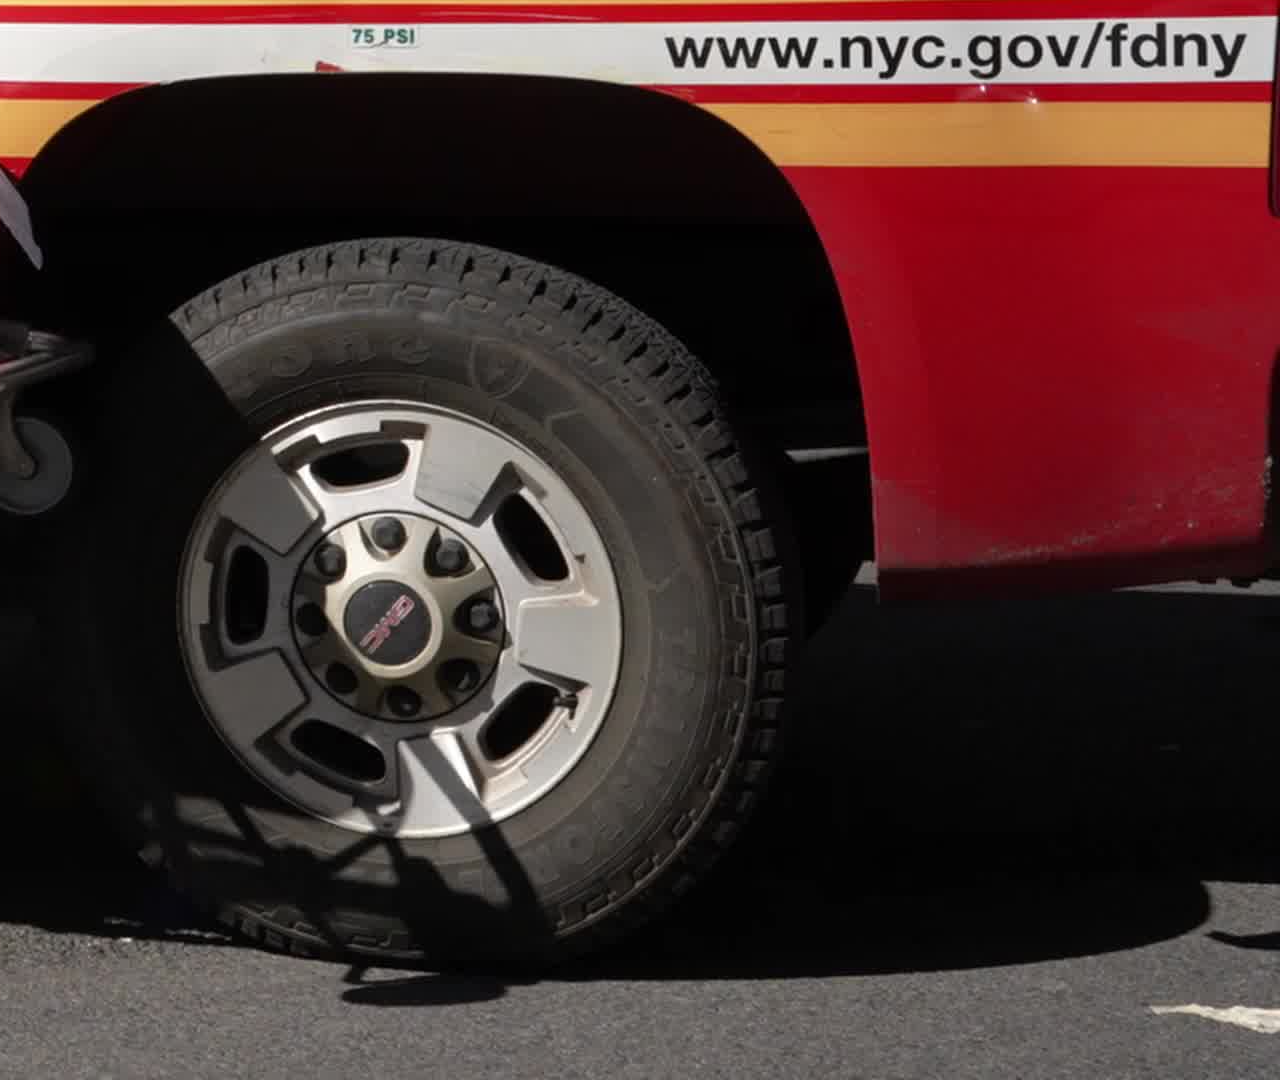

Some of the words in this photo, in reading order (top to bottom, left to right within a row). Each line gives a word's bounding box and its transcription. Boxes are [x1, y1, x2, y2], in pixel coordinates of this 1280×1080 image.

[352, 28, 375, 44] 75
[383, 28, 416, 45] PSI
[664, 20, 1248, 80] www.nyc.gov/fdny
